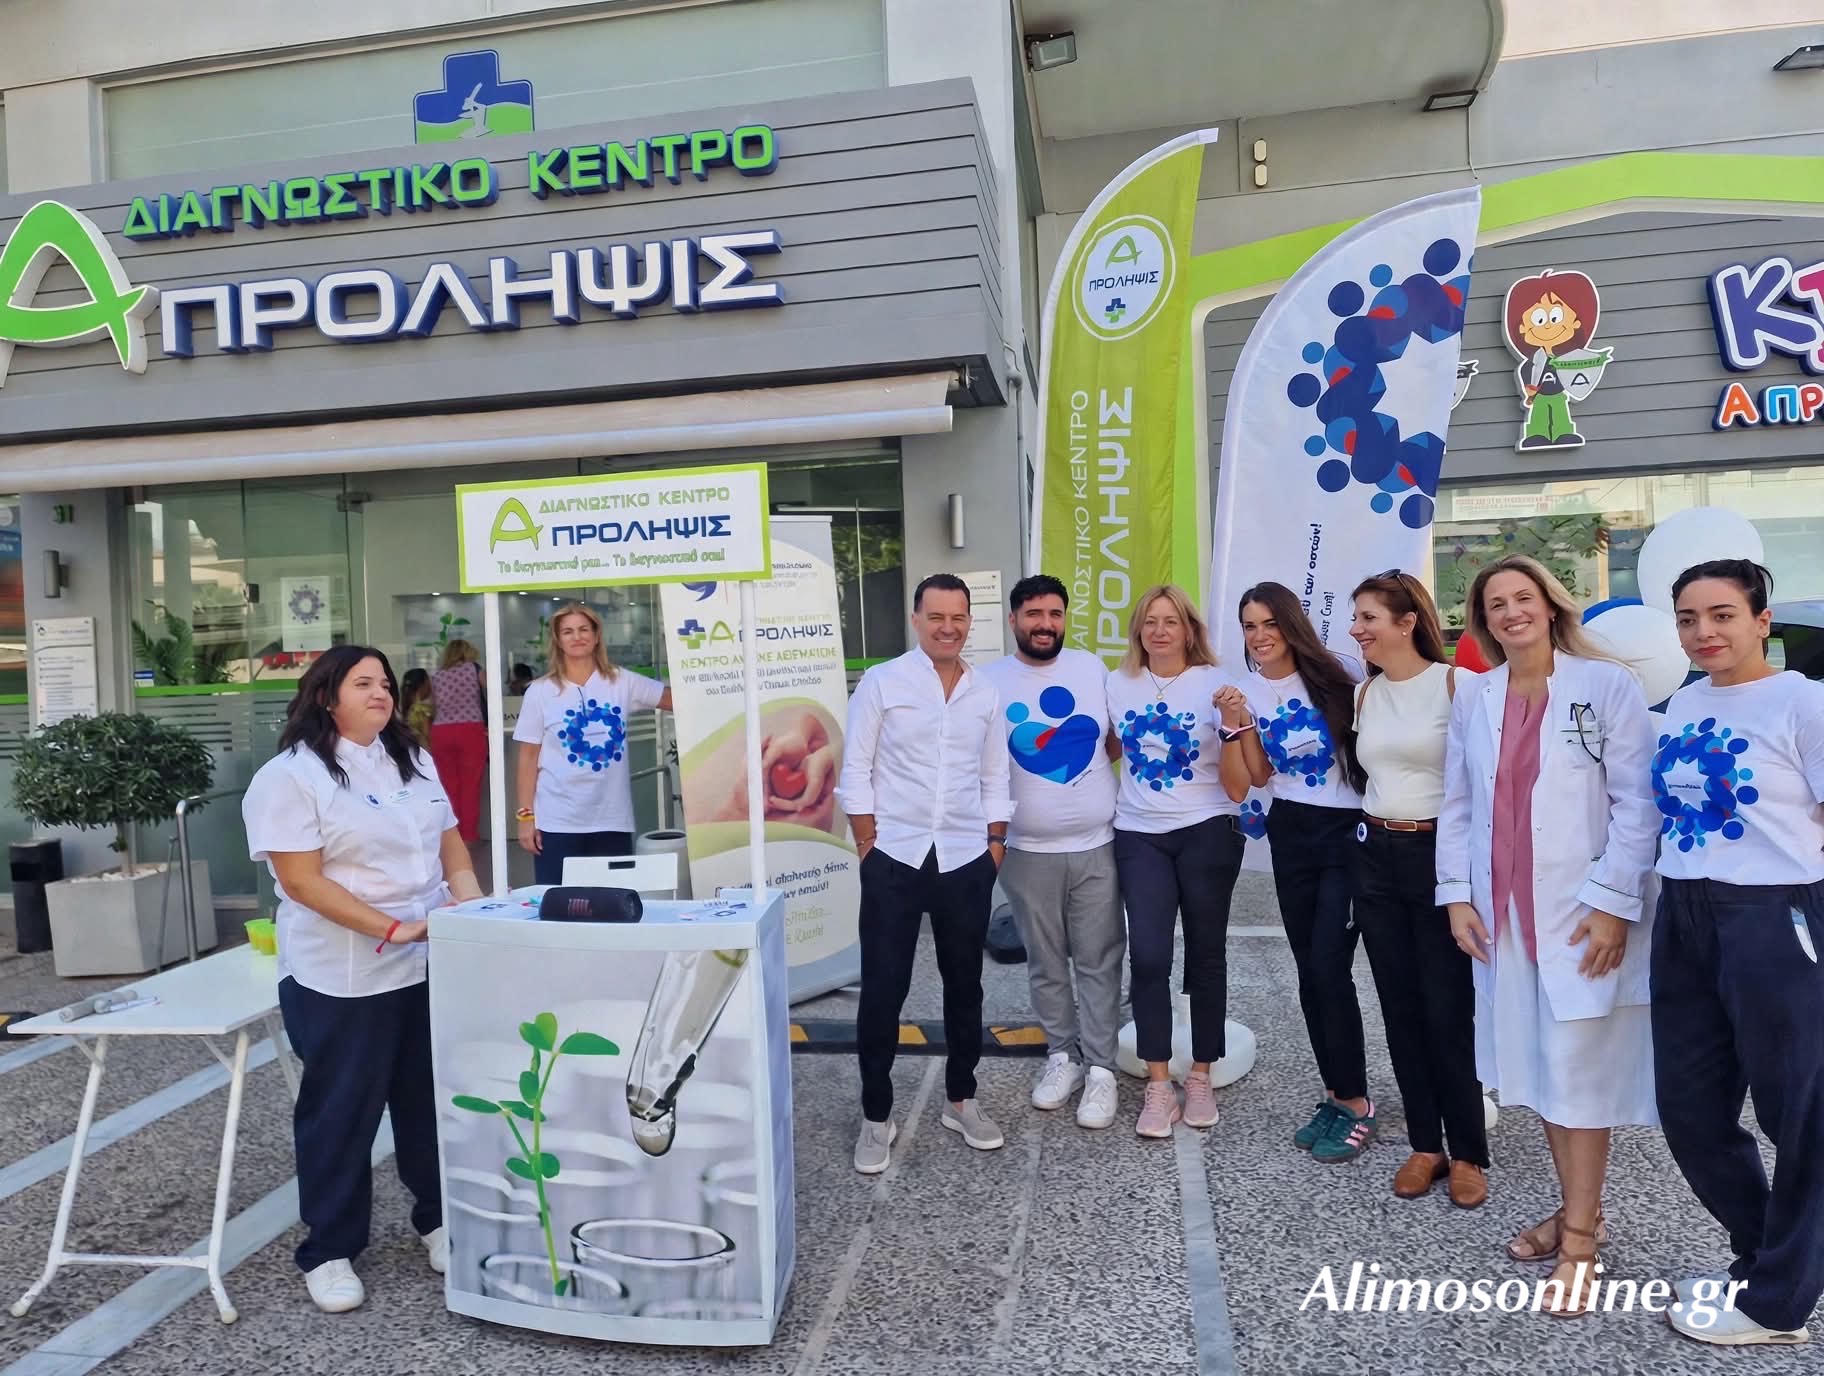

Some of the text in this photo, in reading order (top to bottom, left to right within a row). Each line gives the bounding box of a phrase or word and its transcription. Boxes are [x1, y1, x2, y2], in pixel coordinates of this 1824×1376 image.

[123, 124, 780, 241] ΔΙΑΓΝΩΣΤΙΚΟ ΚΕΝΤΡΟ
[160, 229, 784, 358] ΠΡΟΛΗΨΙΣ
[1089, 271, 1159, 291] ΠΡΟΛΗΨΙΣ
[538, 487, 730, 513] ΔΙΑΓΝΩΣΤΙΚΟ ΚΕΝΤΡΟ
[552, 515, 731, 546] ΠΡΟΛΗΨΙΣ
[1070, 390, 1091, 650] ΑΓΝΩΣΤΙΚΟ ΚΕΝΤΡΟ
